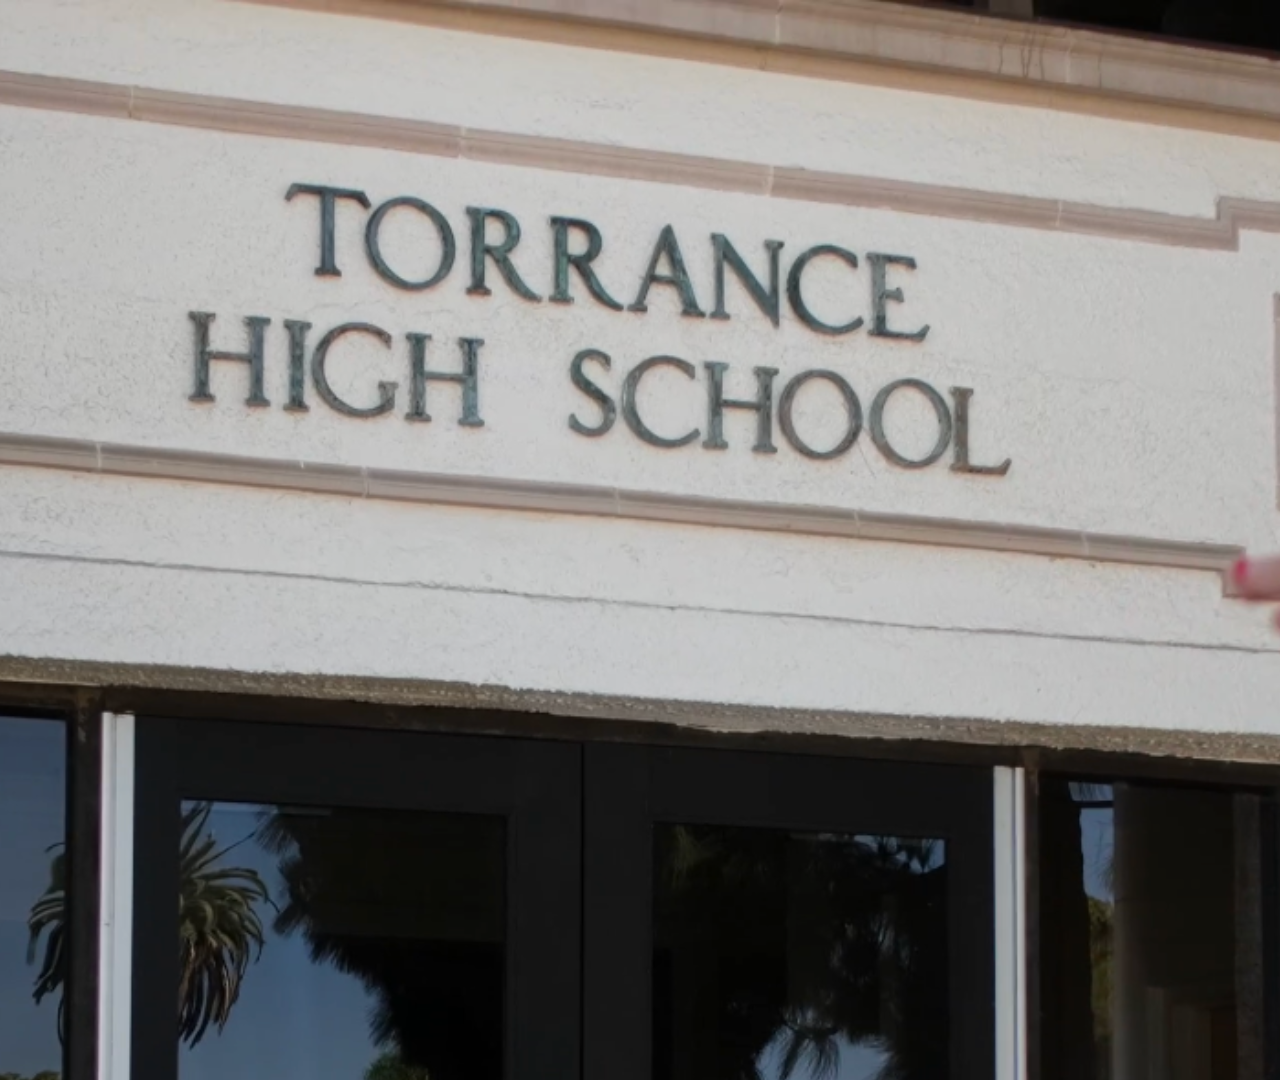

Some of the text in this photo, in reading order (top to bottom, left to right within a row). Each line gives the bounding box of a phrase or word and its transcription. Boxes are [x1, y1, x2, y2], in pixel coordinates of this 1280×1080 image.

[284, 182, 930, 344] TORRANCE
[187, 310, 1013, 477] HIGH SCHOOL
